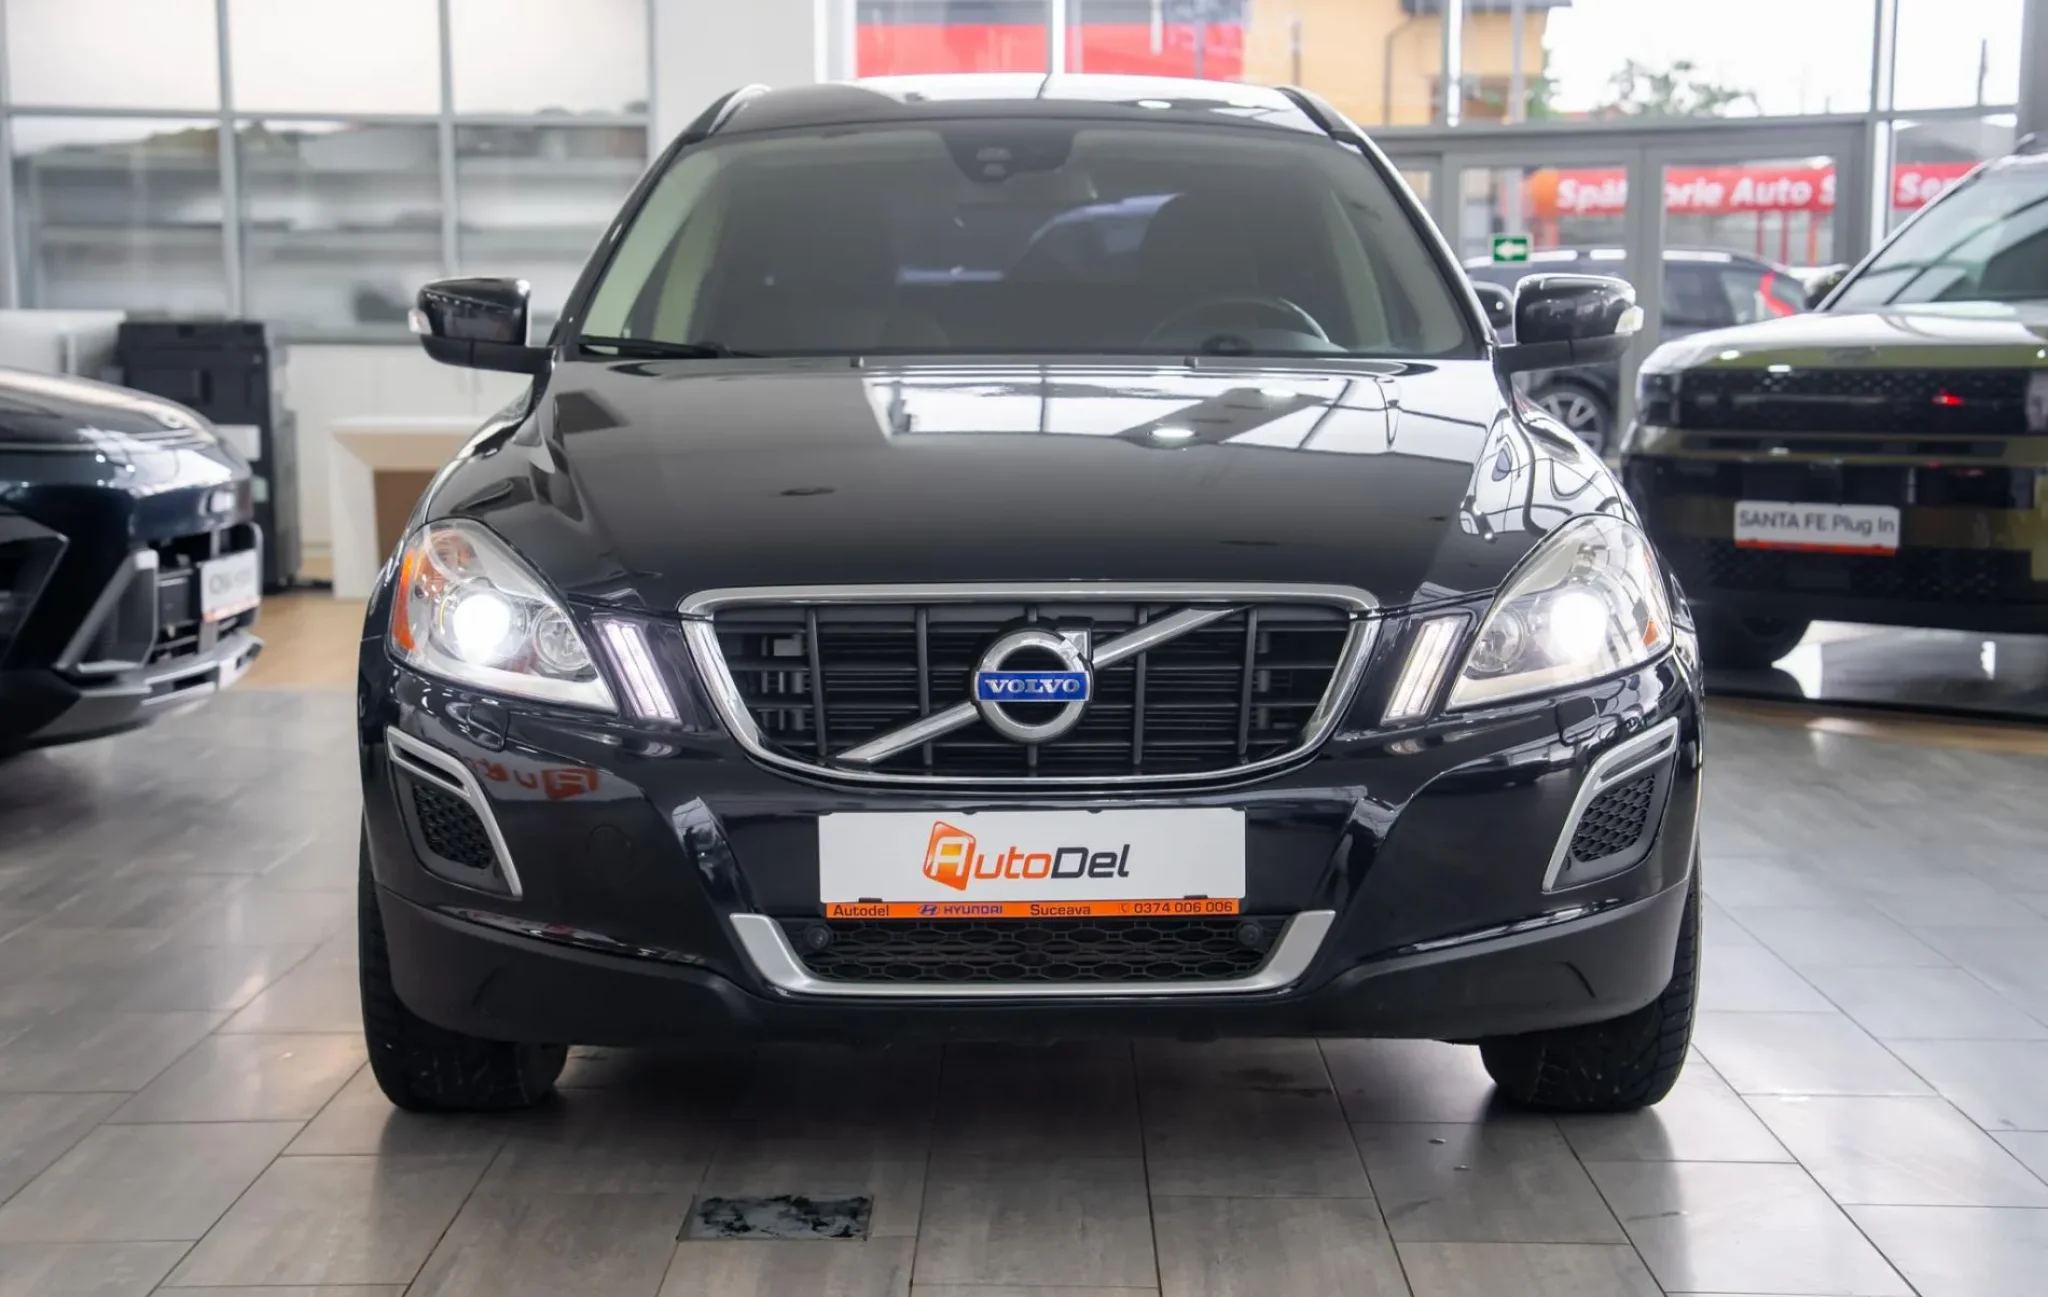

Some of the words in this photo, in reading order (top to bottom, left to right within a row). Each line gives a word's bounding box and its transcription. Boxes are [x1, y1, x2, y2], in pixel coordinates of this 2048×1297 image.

[1730, 176, 1813, 207] Auto
[1738, 510, 1800, 530] SANTA
[1804, 512, 1827, 532] FE
[1832, 514, 1873, 537] Plug
[1878, 516, 1895, 533] In
[984, 678, 1080, 693] VOLVO
[926, 828, 1131, 884] AutoDel
[833, 904, 889, 917] Autodel
[943, 904, 1003, 915] HYUNDAI
[1029, 903, 1091, 916] Suceava
[1134, 902, 1170, 914] 0374
[1174, 901, 1201, 914] 006
[1205, 901, 1233, 913] 006
